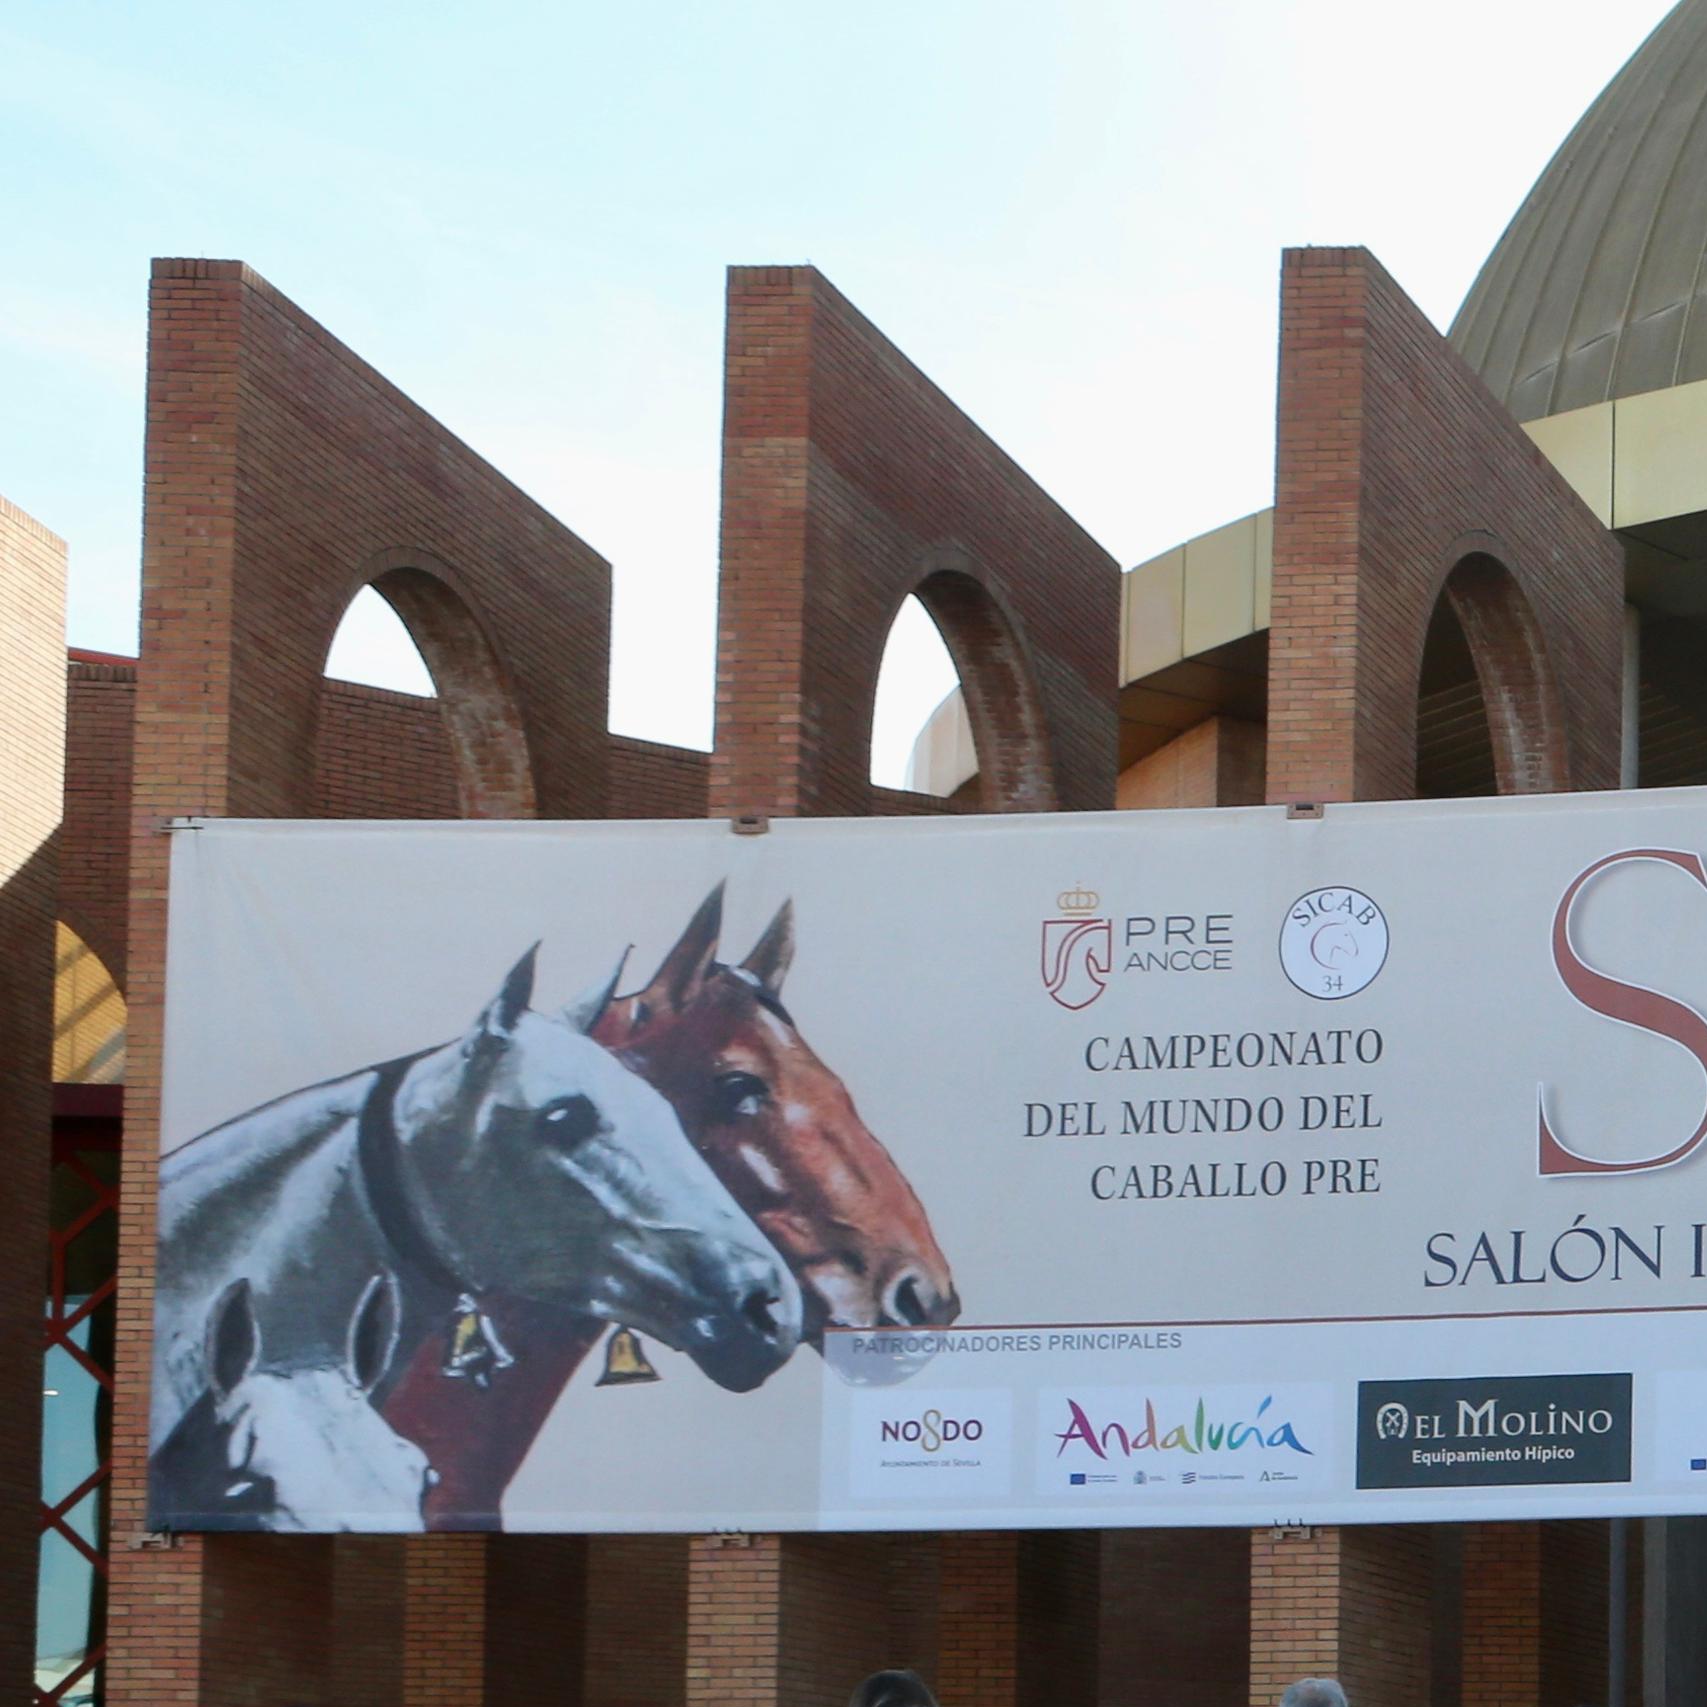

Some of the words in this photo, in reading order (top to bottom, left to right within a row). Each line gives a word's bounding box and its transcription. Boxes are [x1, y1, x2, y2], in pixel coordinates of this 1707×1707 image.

[1291, 891, 1377, 928] SICAB
[1125, 914, 1234, 946] PRE
[1124, 950, 1233, 973] ANCCE
[1321, 974, 1344, 994] 34
[1084, 1028, 1384, 1072] CAMPEONATO
[1024, 1101, 1107, 1137] DEL
[1120, 1096, 1284, 1135] MUNDO
[1299, 1093, 1384, 1131] DEL
[1090, 1160, 1288, 1201] CABALLO
[1302, 1158, 1382, 1196] PRE
[1423, 1213, 1664, 1288] SALÓN
[852, 1334, 1042, 1355] PATROCINADORES
[1048, 1332, 1183, 1352] PRINCIPALES
[1053, 1394, 1316, 1461] Andalucía
[1414, 1415, 1446, 1440] EL
[1412, 1447, 1521, 1467] Equipamiento
[1524, 1446, 1575, 1465] Hípico
